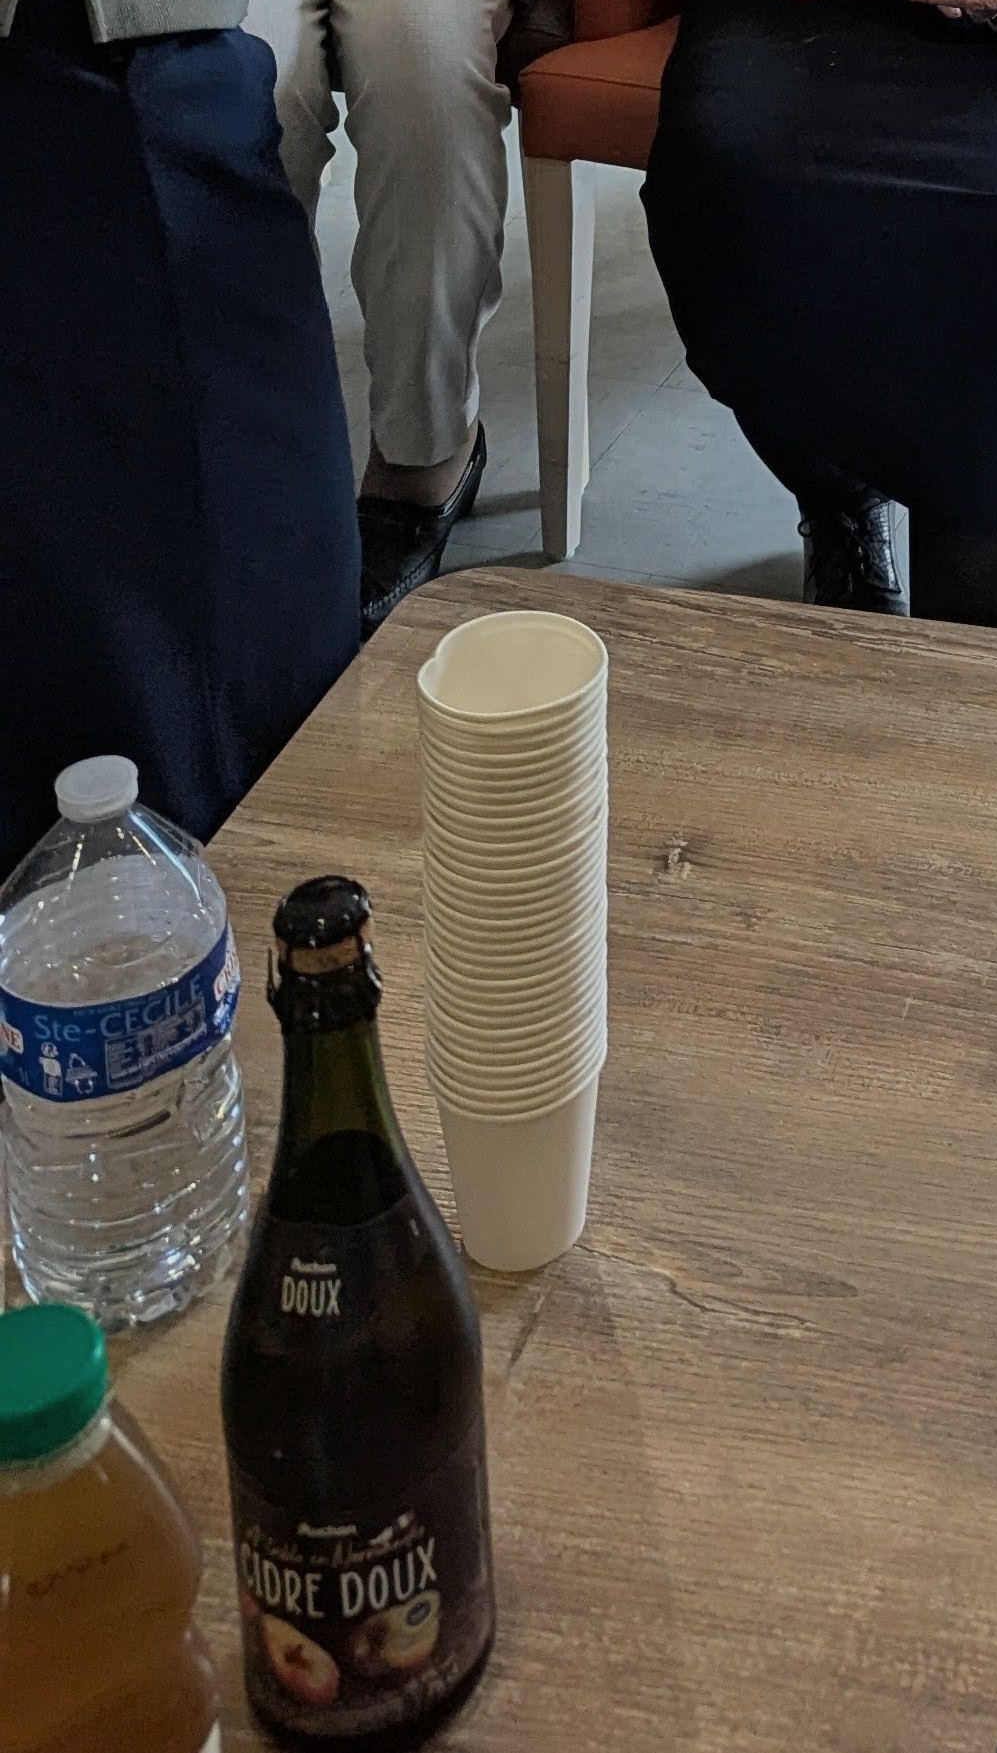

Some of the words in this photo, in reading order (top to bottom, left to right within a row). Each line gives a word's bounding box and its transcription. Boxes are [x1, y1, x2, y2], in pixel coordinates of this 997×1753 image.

[281, 1274, 342, 1318] DOUX
[240, 1542, 325, 1619] CIDRE
[339, 1536, 437, 1619] DOUX
